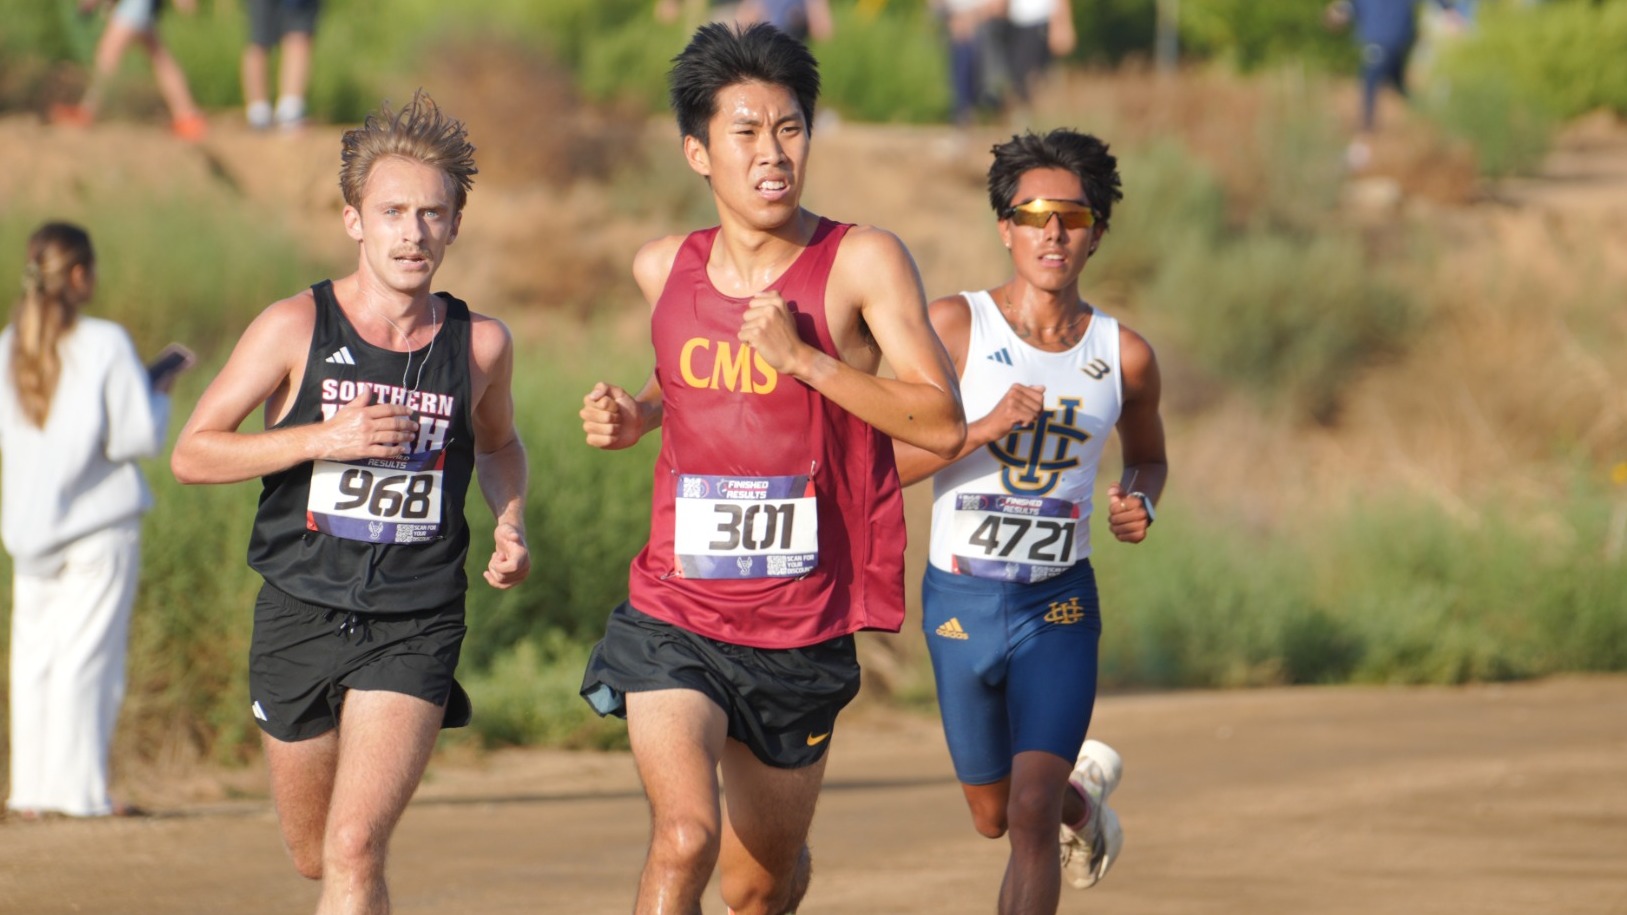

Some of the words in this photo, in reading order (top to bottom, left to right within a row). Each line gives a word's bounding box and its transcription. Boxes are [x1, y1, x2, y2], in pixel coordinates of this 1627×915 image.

[680, 337, 778, 395] CMS
[367, 458, 407, 469] RESULTS
[727, 480, 769, 488] FINISHED
[334, 468, 434, 519] 968
[726, 490, 767, 499] RESULTS
[1004, 497, 1043, 507] FINISHED
[1002, 507, 1040, 515] RESULTS
[709, 503, 795, 550] 301
[968, 515, 1076, 562] 4721
[935, 628, 969, 640] adidas
